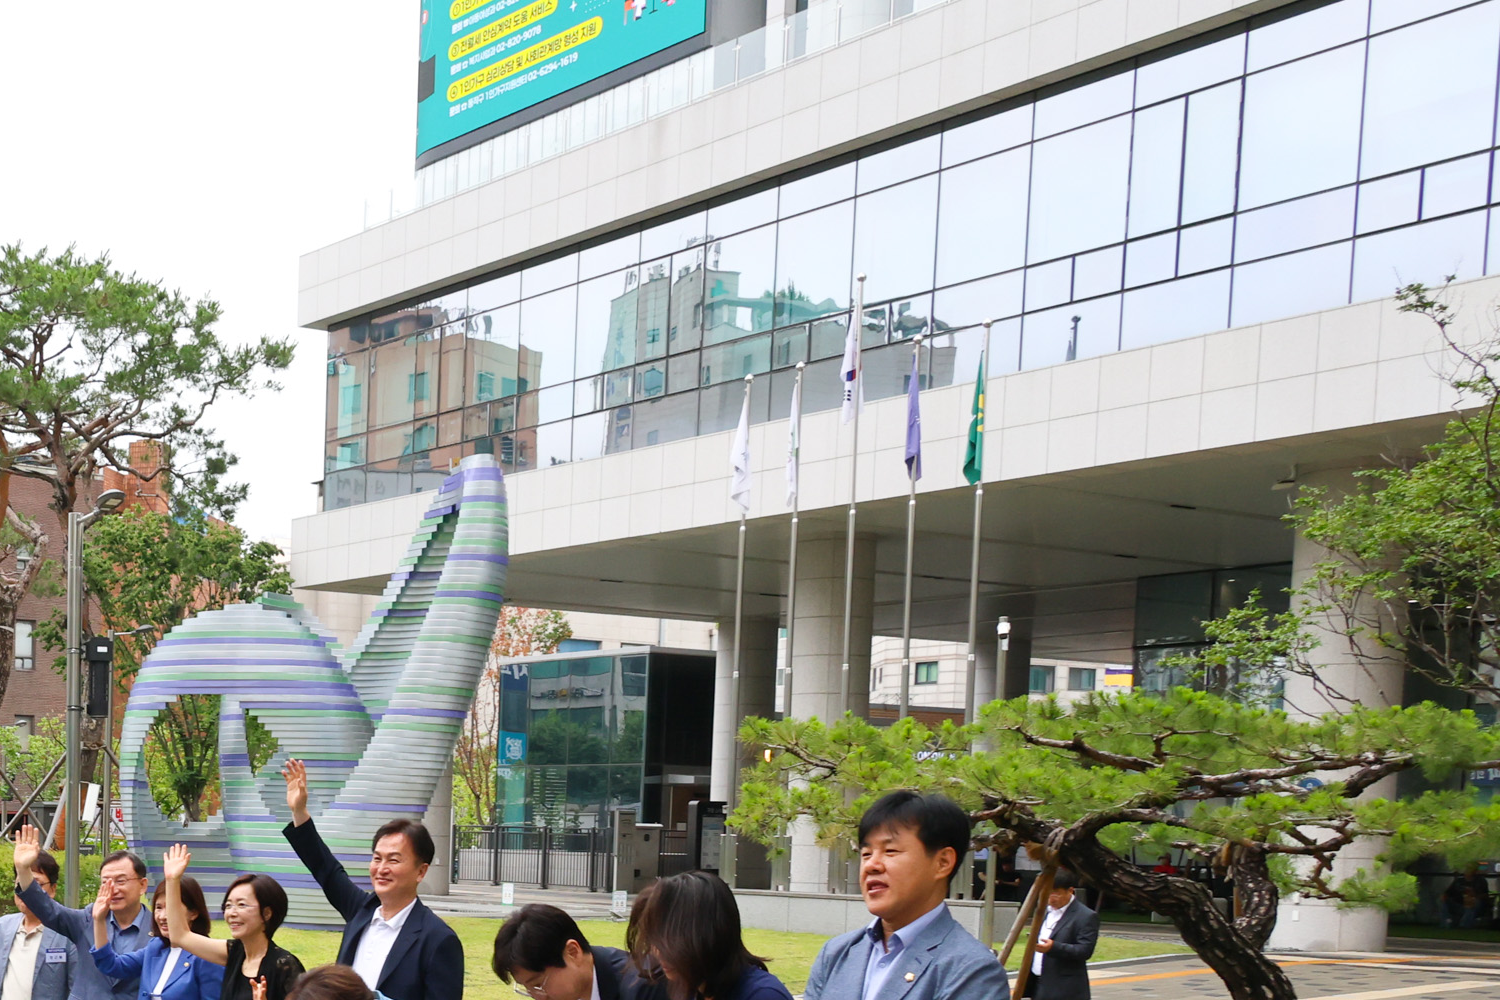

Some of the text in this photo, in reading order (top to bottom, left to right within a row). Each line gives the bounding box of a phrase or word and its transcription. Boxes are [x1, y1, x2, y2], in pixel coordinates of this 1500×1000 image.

[460, 35, 482, 54] 전월세
[483, 17, 512, 43] 안심계약
[513, 10, 528, 27] 도움
[529, 0, 553, 19] 서비스
[495, 24, 542, 54] 02-820-9078
[460, 73, 485, 94] 1인가구
[486, 63, 514, 83] 심리상담
[515, 55, 524, 69] 및
[525, 38, 563, 65] 사회관계망
[564, 30, 579, 47] 형성
[581, 22, 597, 40] 지원
[528, 51, 579, 82] 02-6294-1619
